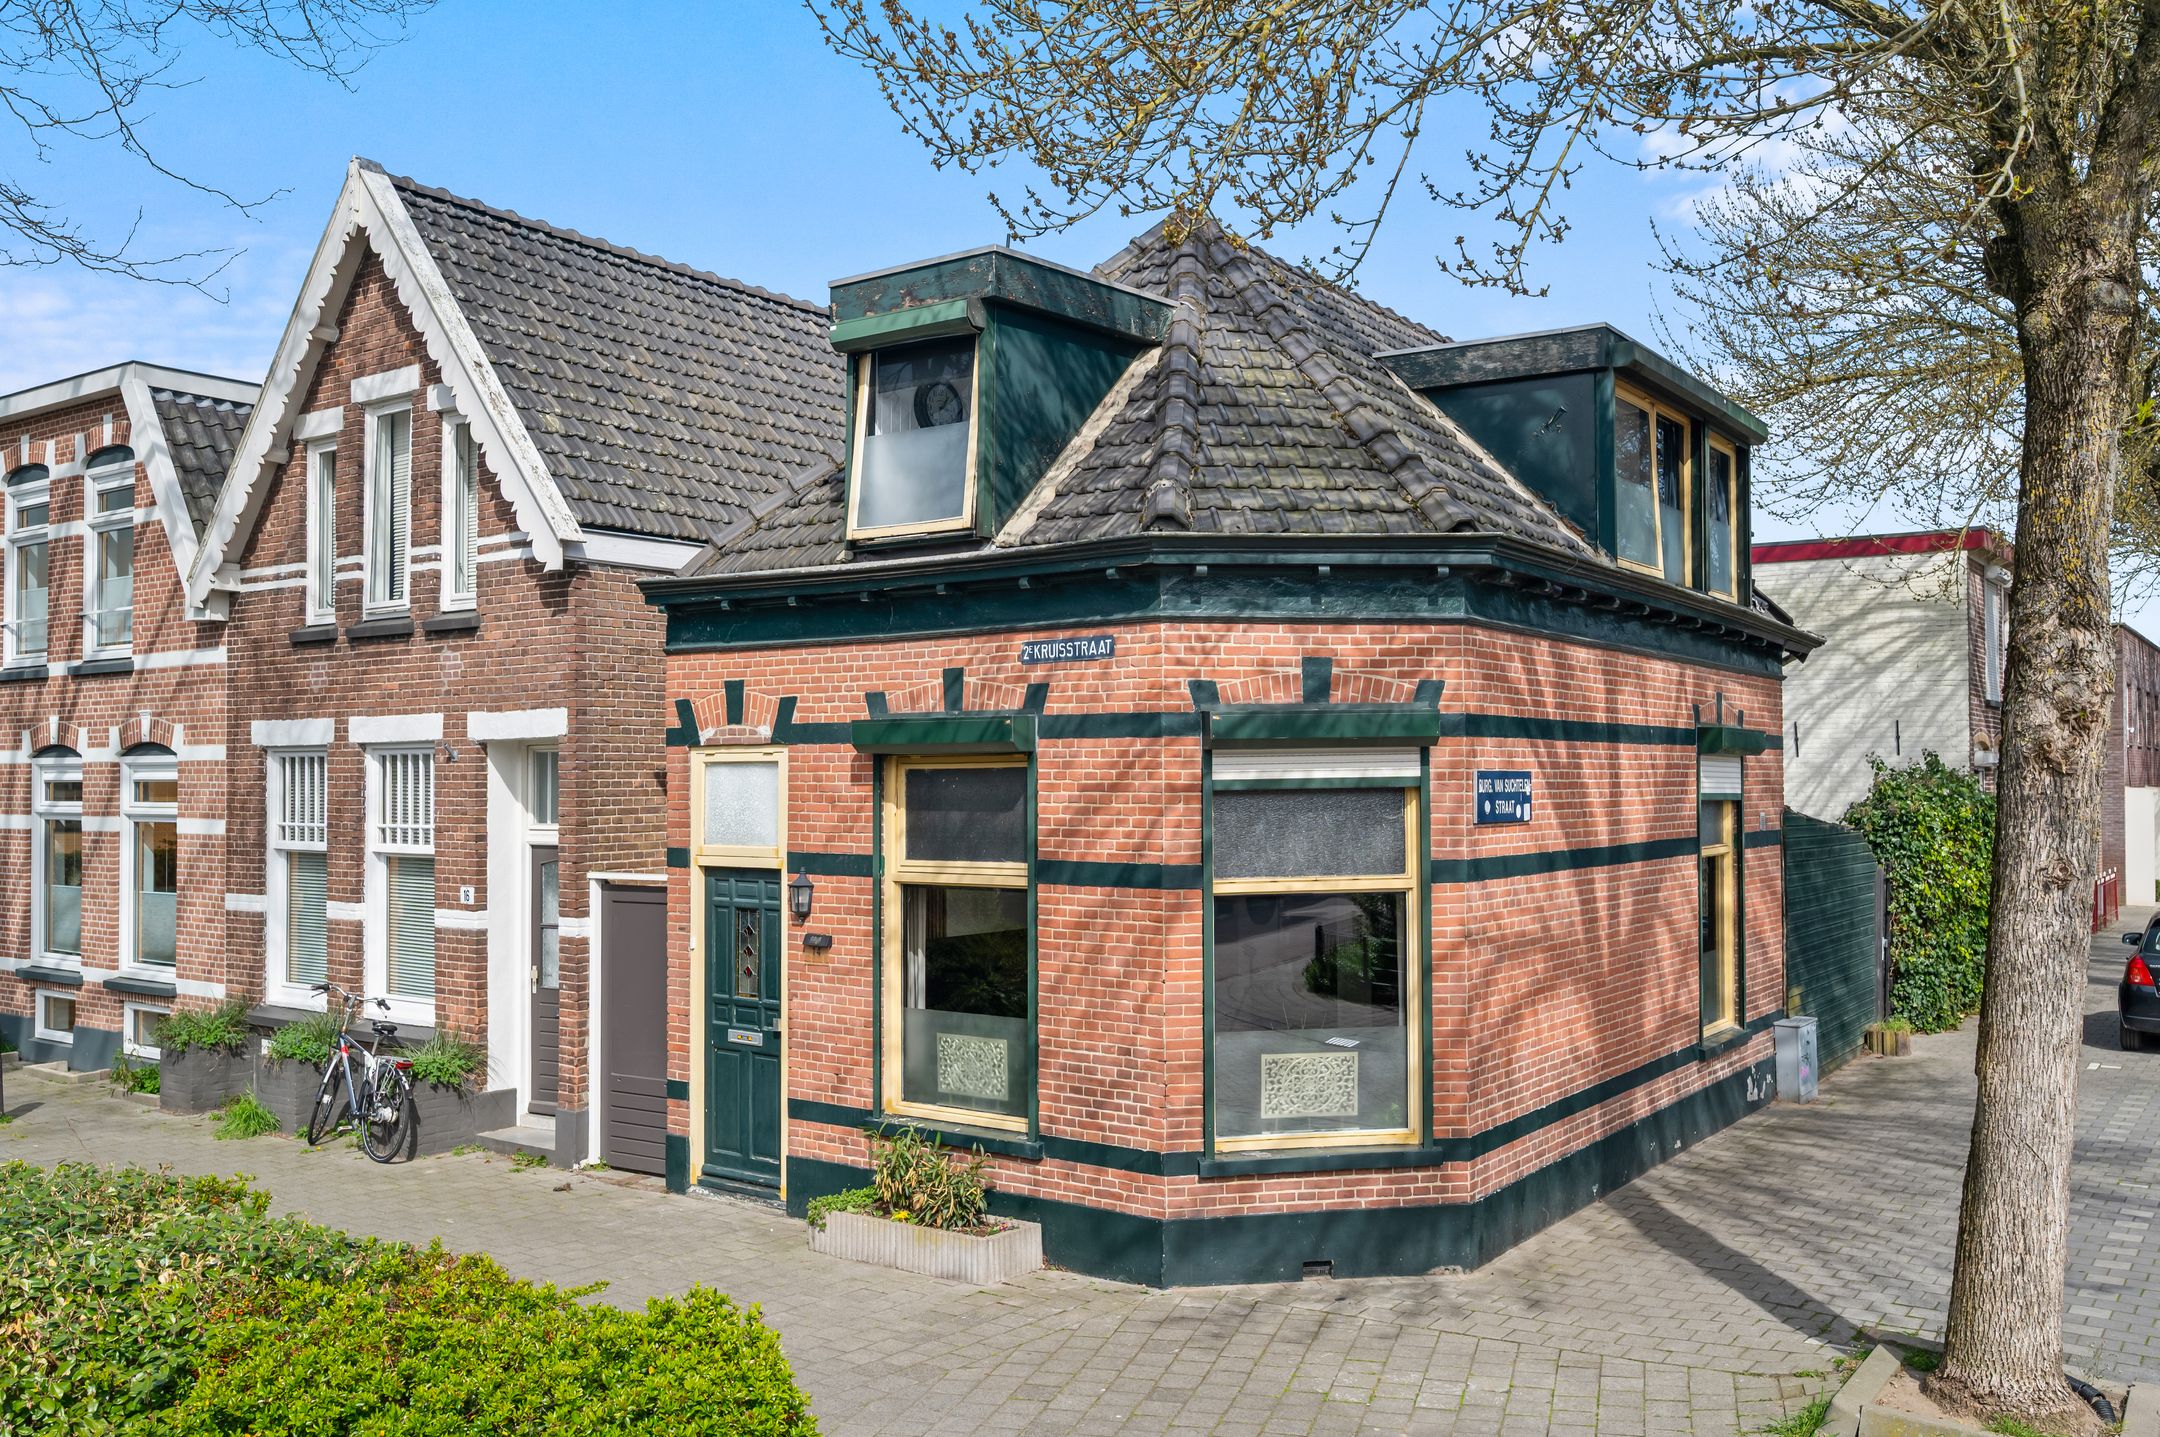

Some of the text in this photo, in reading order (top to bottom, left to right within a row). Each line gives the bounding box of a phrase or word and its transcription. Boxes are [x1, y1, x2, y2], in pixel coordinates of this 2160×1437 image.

[1494, 778, 1504, 793] VAN
[1495, 800, 1515, 814] STRAAT
[463, 889, 470, 902] 16
